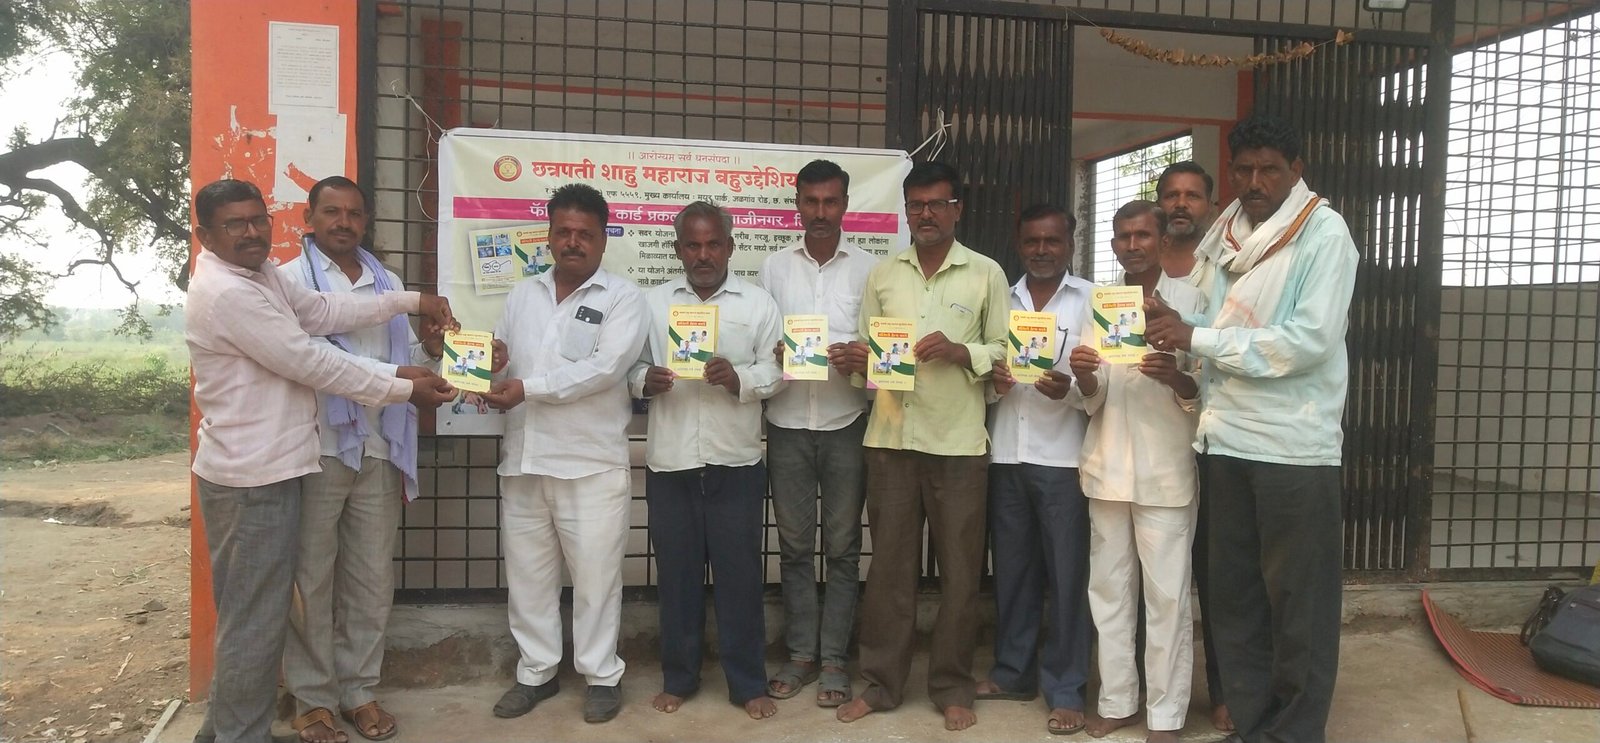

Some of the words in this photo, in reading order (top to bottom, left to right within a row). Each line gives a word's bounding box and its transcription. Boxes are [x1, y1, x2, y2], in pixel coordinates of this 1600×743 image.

[678, 151, 692, 162] सर्व
[532, 158, 596, 180] छत्रपती
[601, 163, 638, 188] शाहु
[642, 166, 710, 186] महाराज
[644, 191, 660, 201] मुख्य
[662, 190, 690, 200] कार्यालय
[615, 205, 643, 221] कार्ड
[638, 229, 652, 237] सदर
[638, 239, 660, 248] खाजगी
